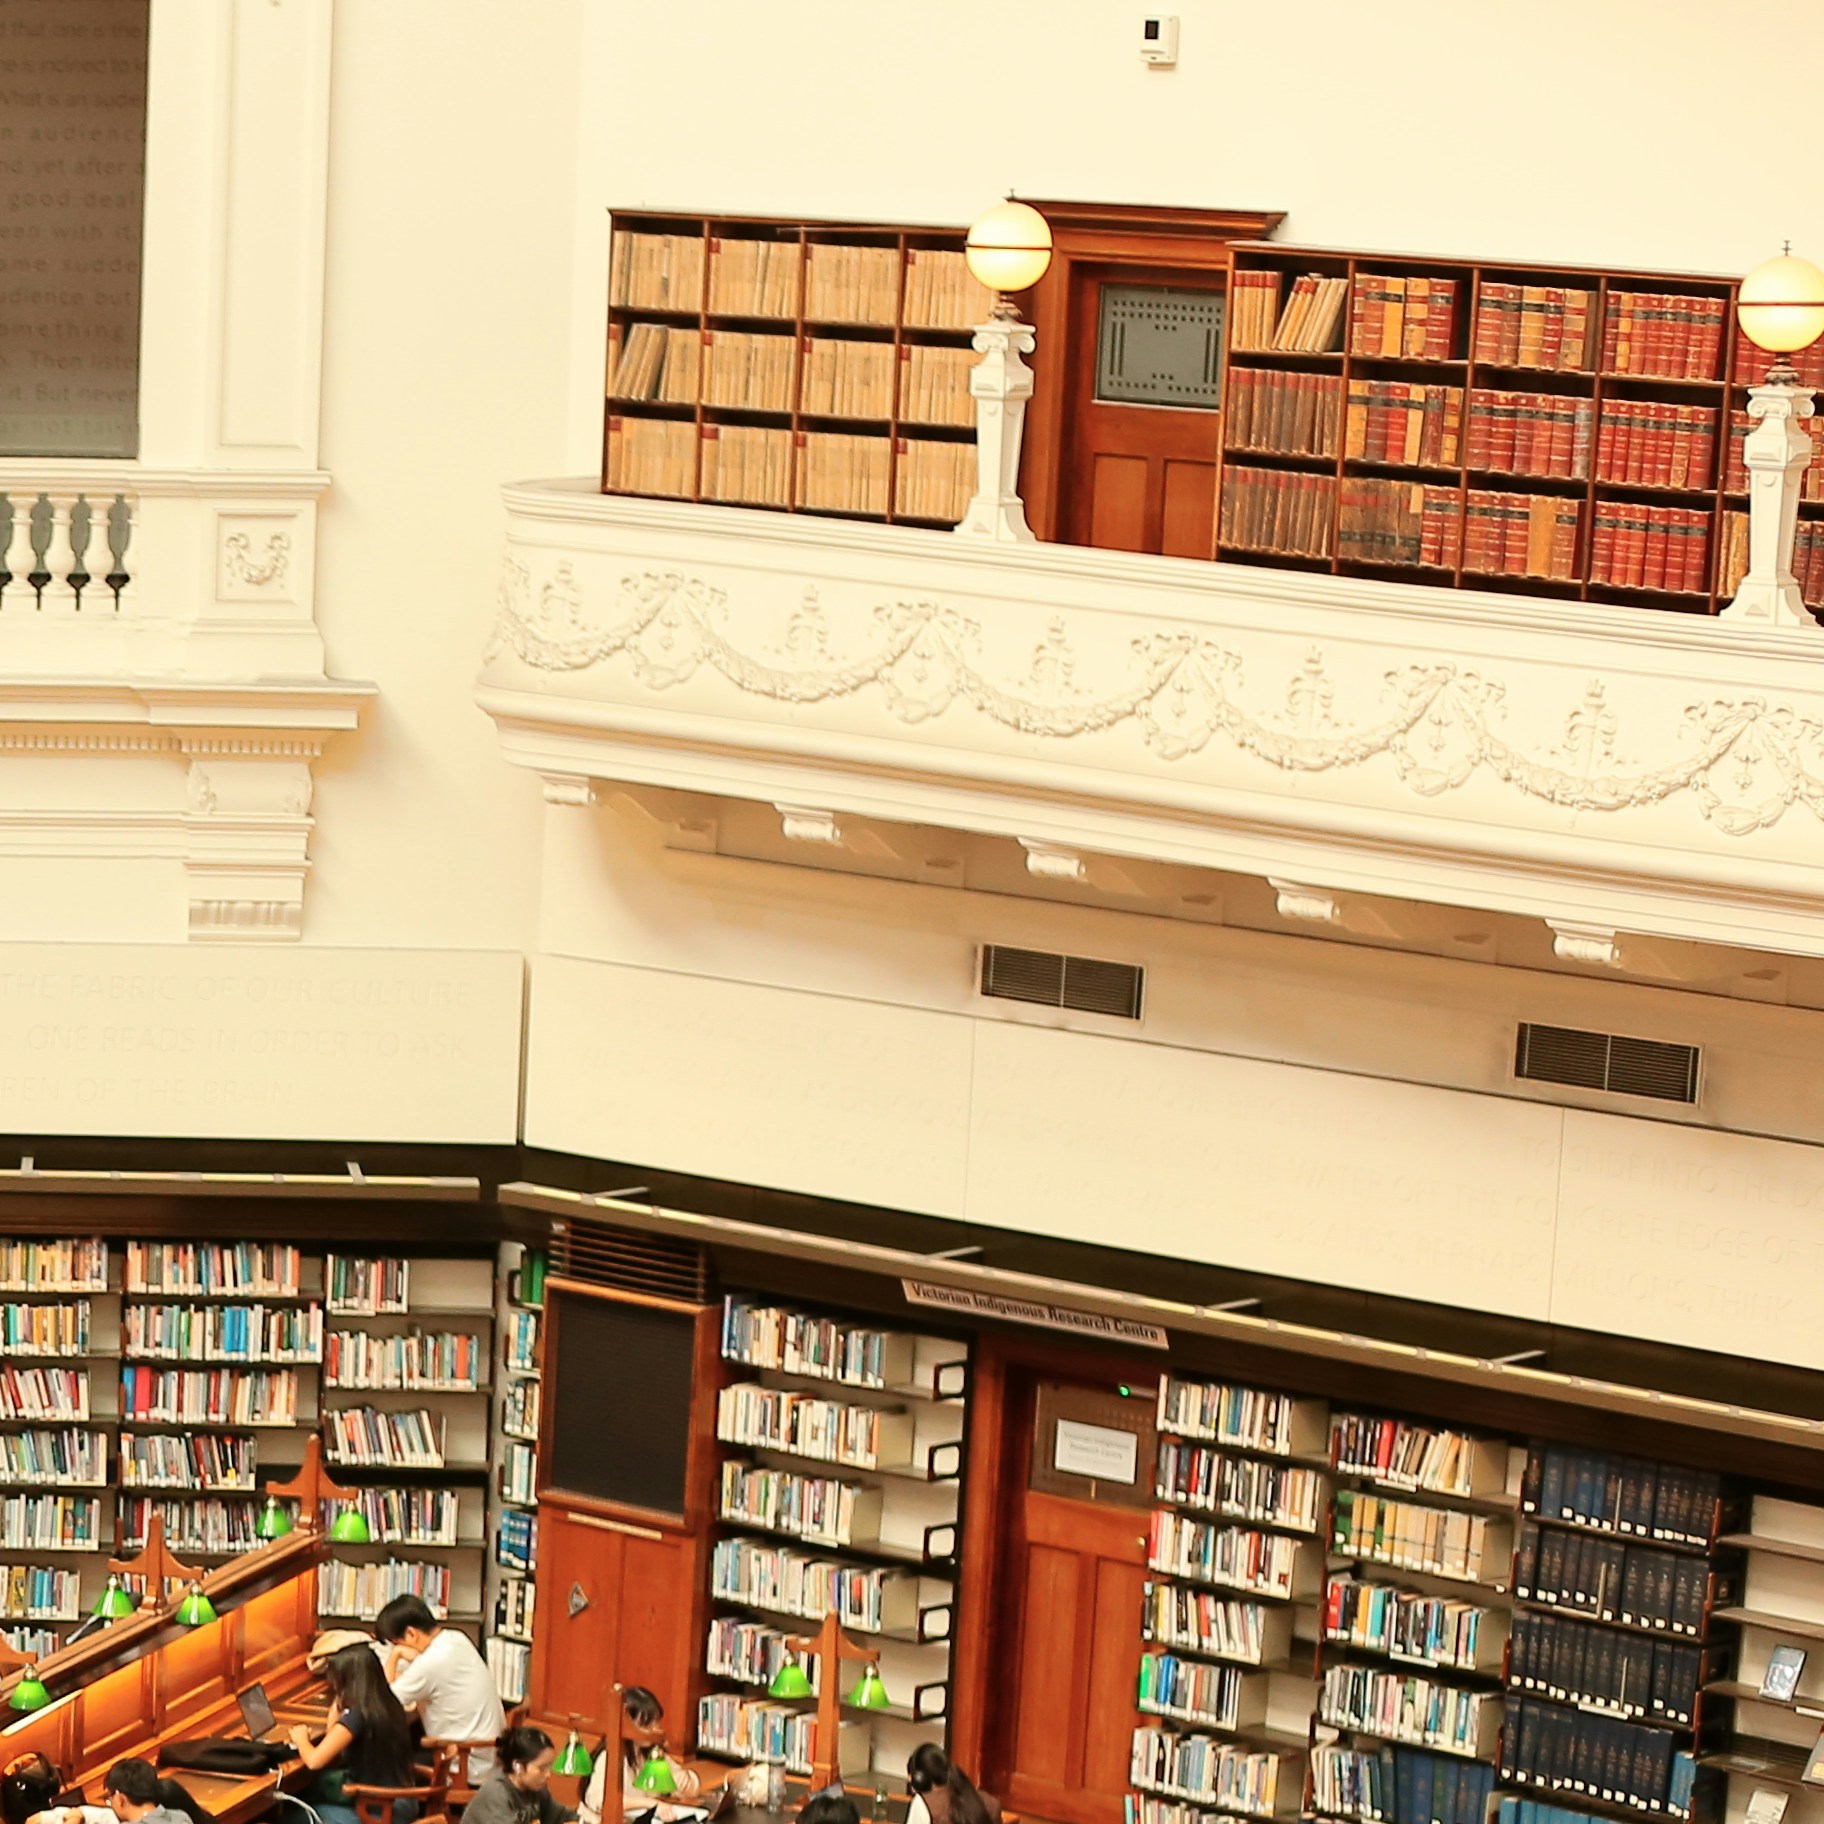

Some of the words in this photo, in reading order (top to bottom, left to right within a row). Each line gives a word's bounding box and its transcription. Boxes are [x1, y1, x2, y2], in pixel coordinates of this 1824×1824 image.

[70, 971, 179, 1002] FABRIC
[192, 974, 235, 1002] OF
[328, 976, 471, 1009] CULTURE
[912, 1283, 971, 1306] Victorian
[974, 1292, 1046, 1321] Indigenous
[1048, 1306, 1111, 1332] Research
[1114, 1317, 1159, 1341] Centre
